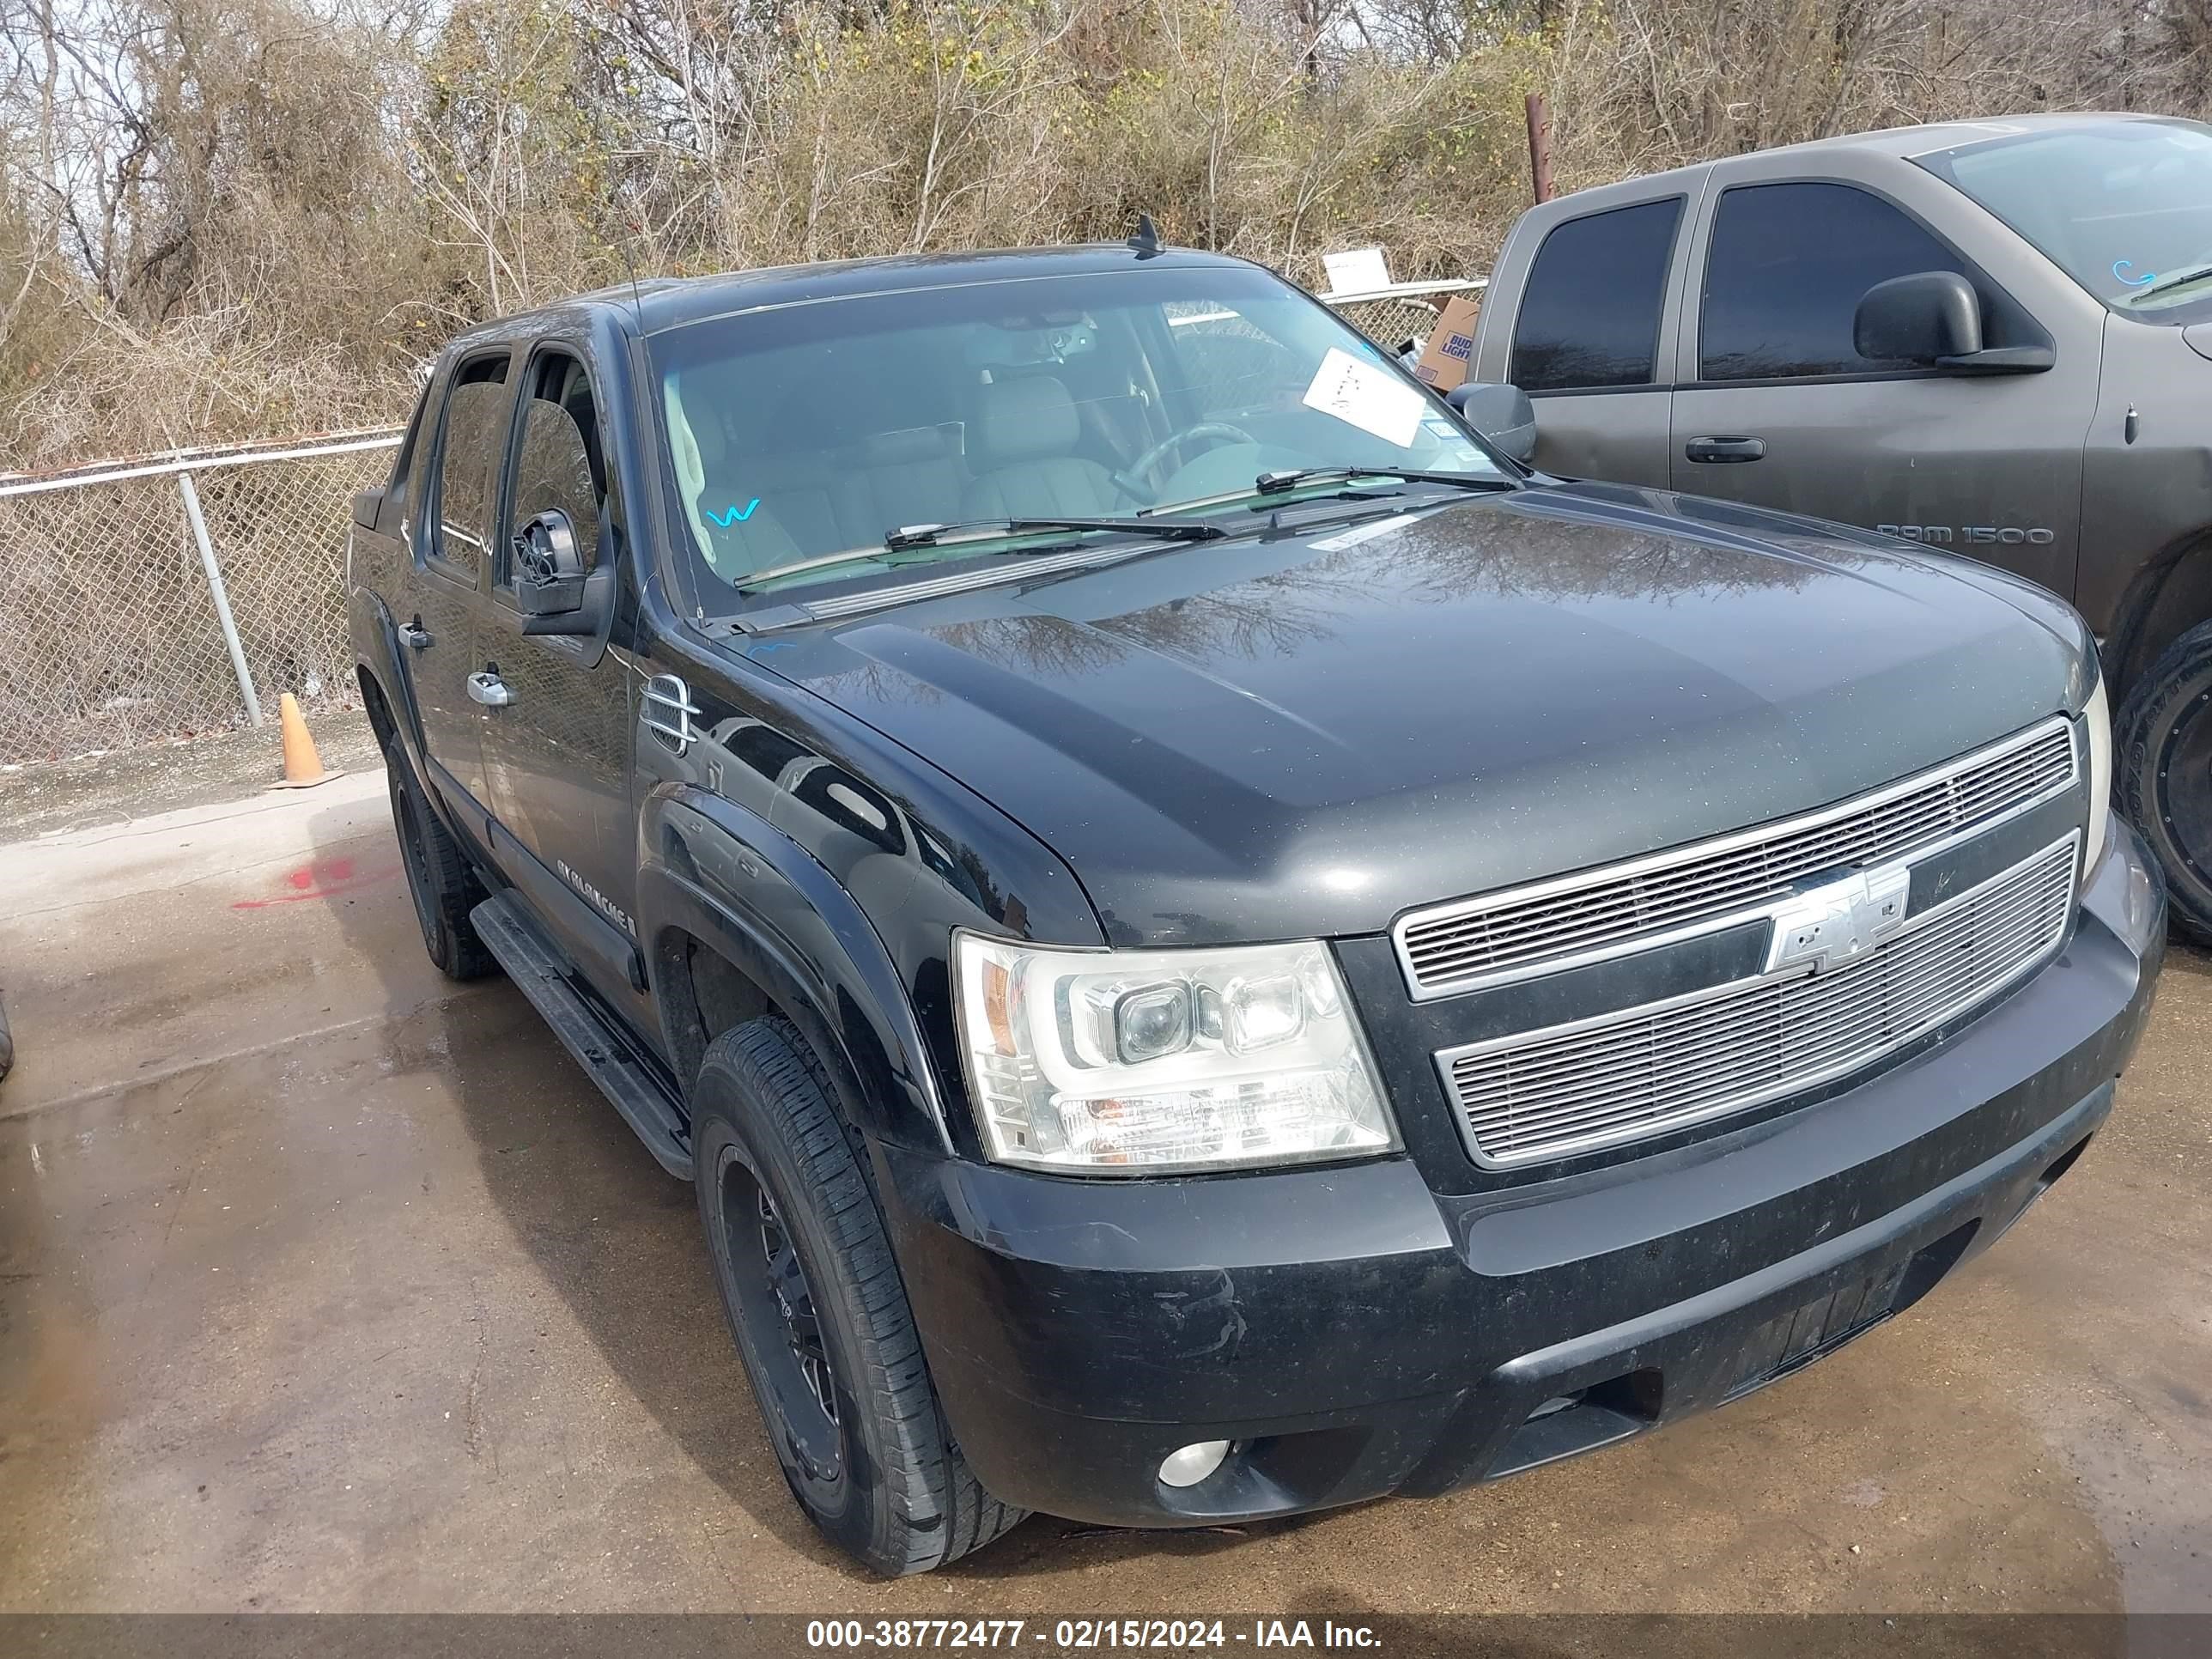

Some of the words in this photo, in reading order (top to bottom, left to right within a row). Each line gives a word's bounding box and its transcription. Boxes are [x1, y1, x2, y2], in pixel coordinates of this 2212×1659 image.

[1449, 334, 1472, 349] BUD
[1962, 526, 2054, 544] 1500
[556, 859, 628, 930] AVALANCHE
